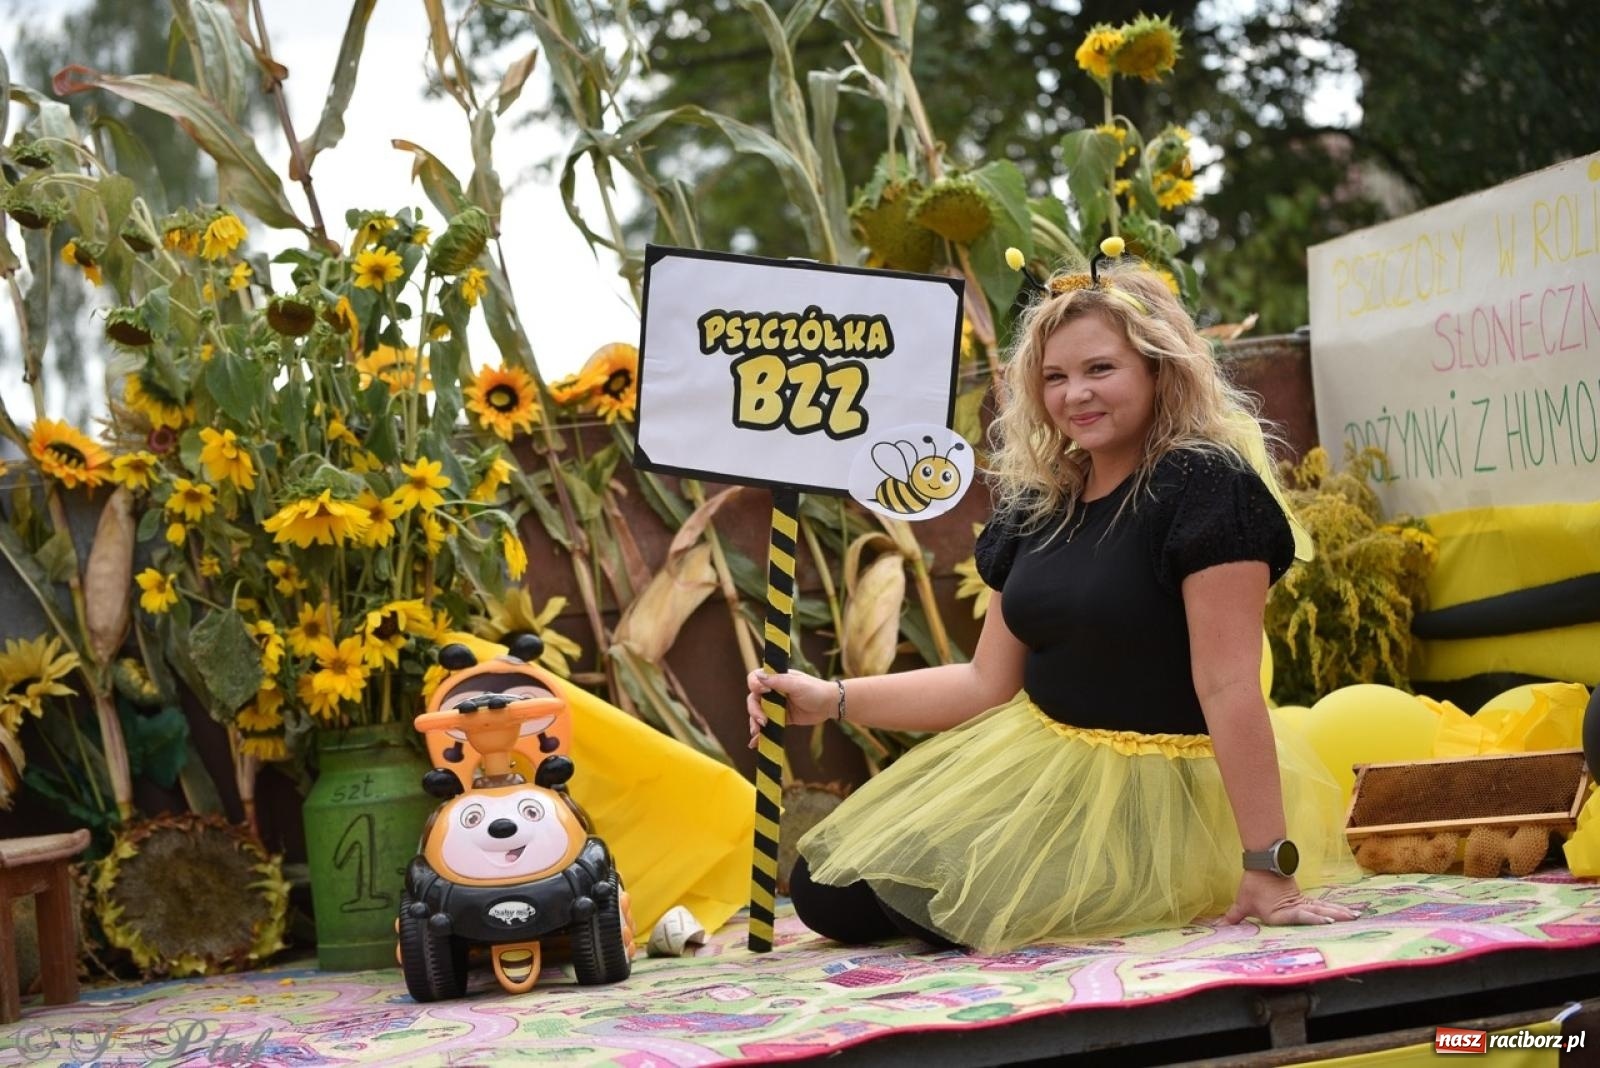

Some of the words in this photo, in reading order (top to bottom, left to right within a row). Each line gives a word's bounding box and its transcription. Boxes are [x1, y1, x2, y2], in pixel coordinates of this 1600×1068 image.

[1331, 224, 1467, 324] PSZCZOŁY
[1494, 211, 1517, 278] W
[698, 305, 895, 359] PSZCZÓŁKA
[730, 353, 869, 441] BZZ
[1472, 398, 1497, 472] Z
[1504, 379, 1600, 471] HUMO
